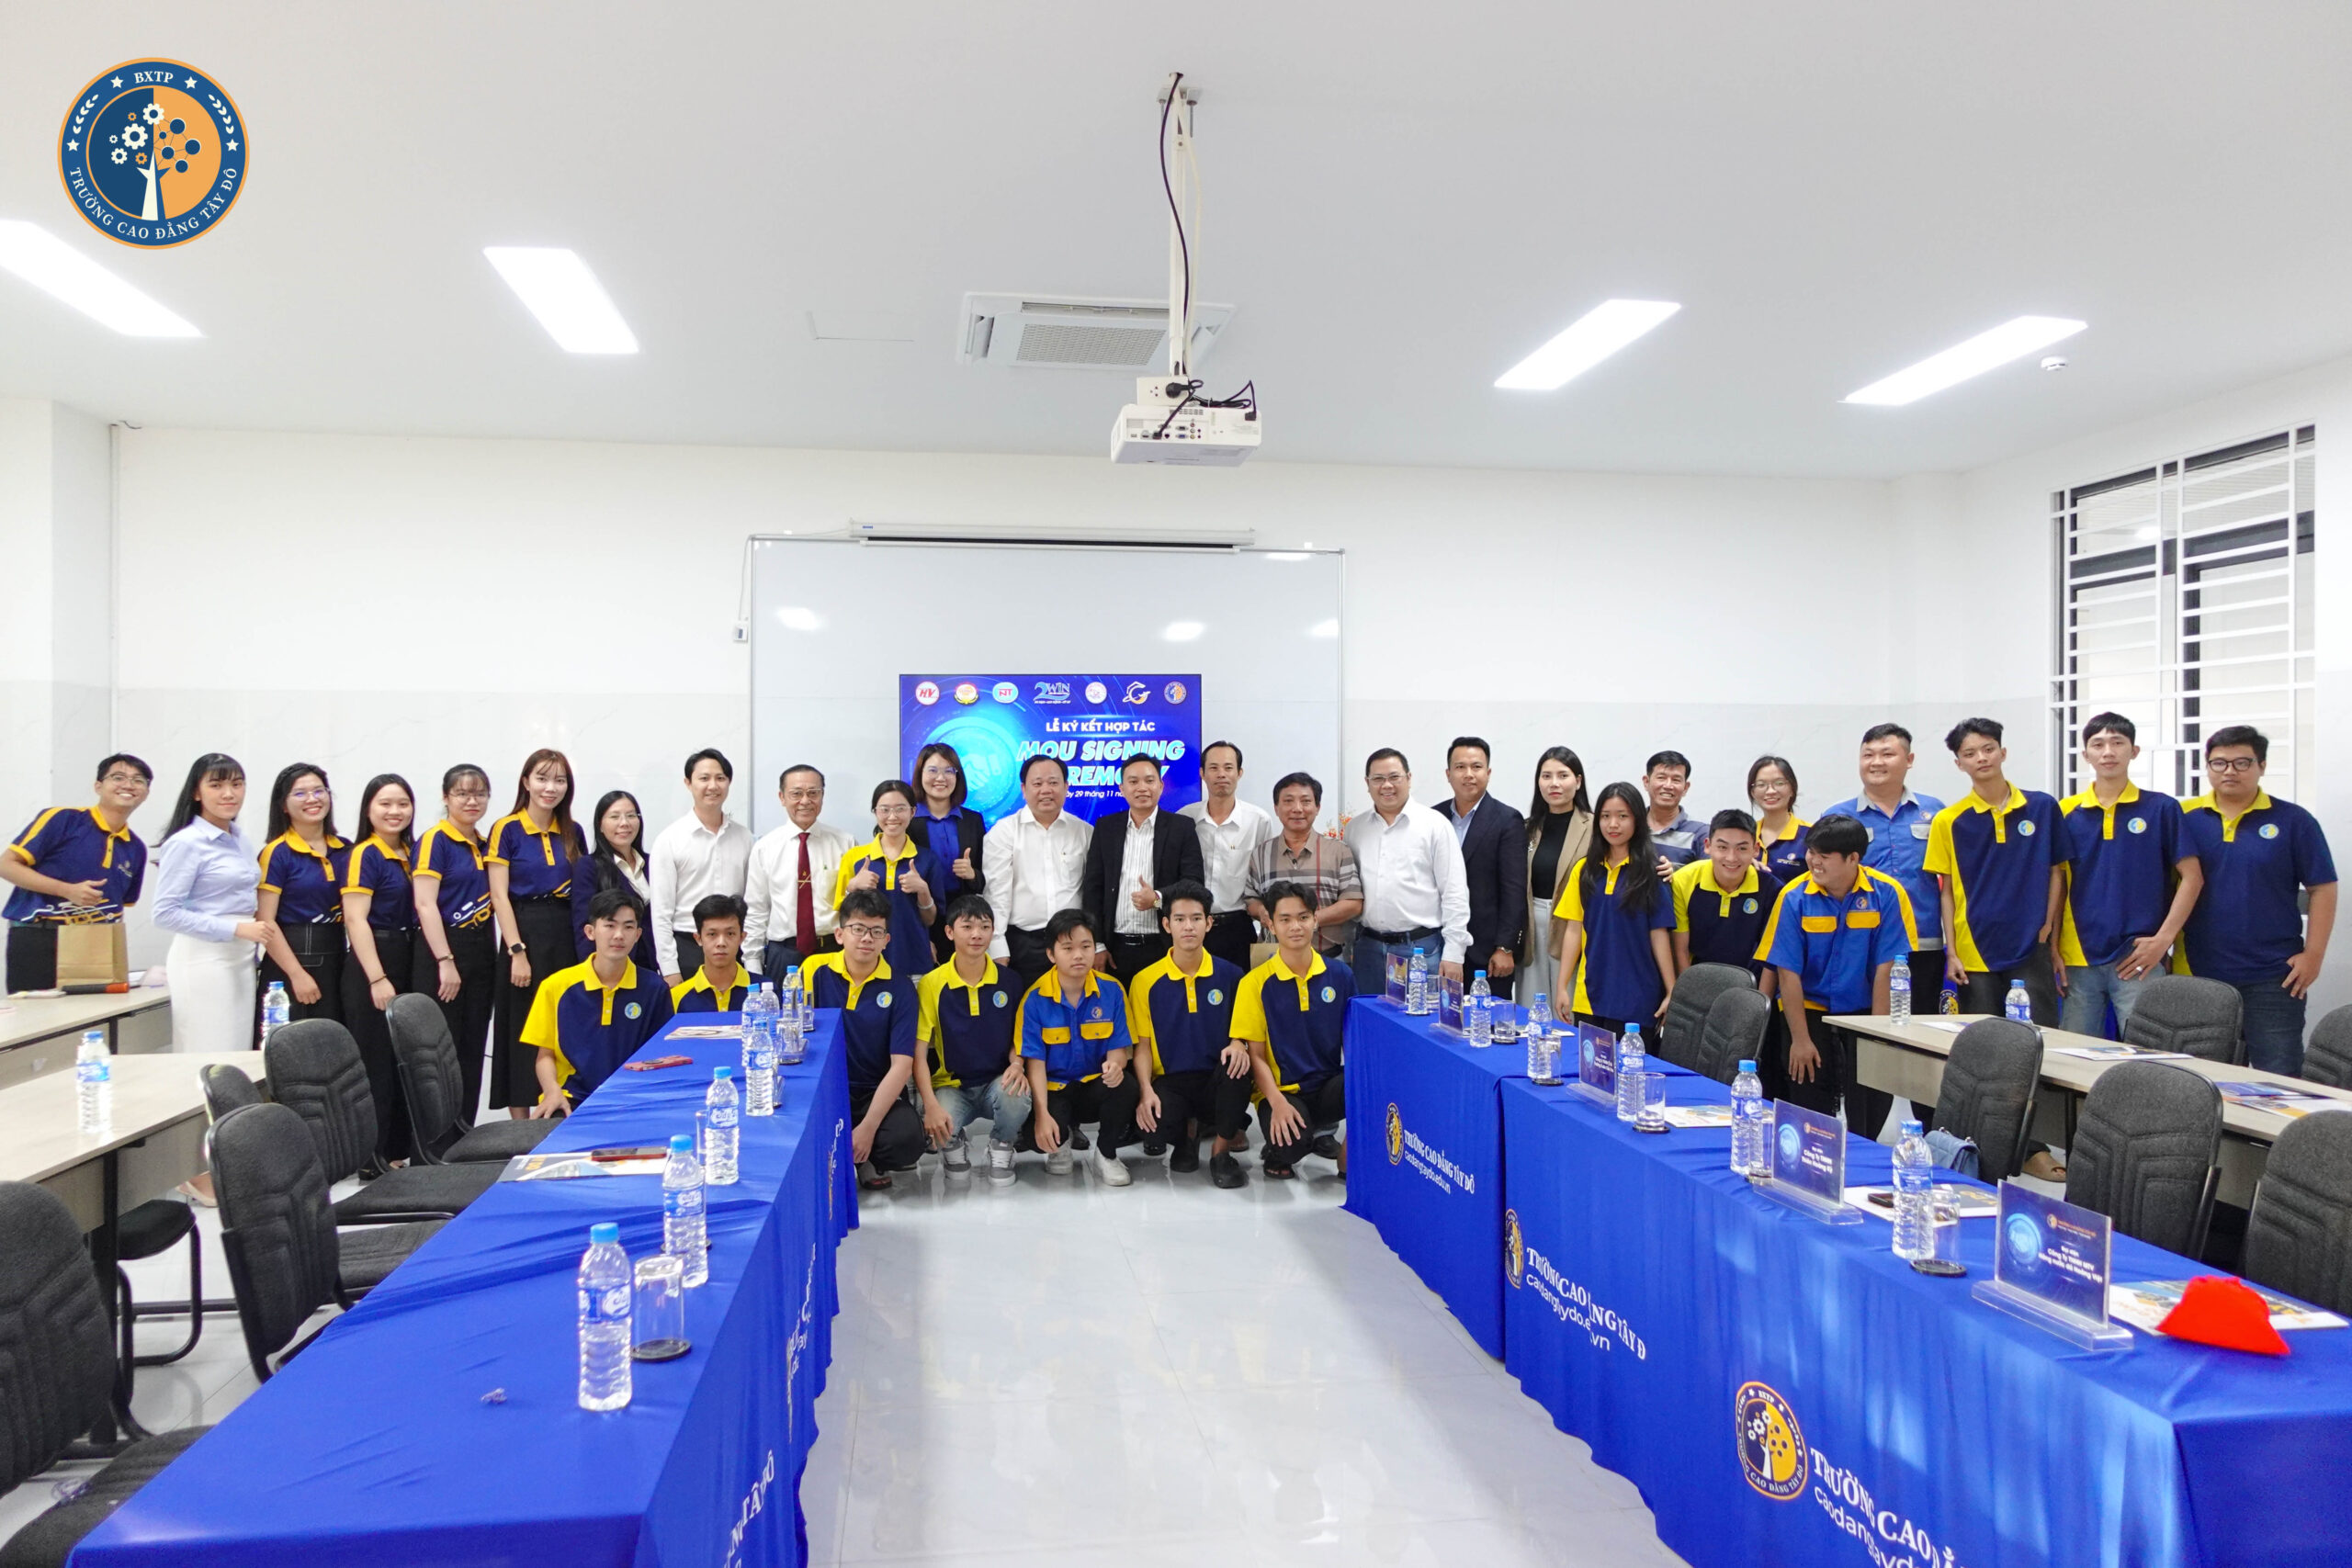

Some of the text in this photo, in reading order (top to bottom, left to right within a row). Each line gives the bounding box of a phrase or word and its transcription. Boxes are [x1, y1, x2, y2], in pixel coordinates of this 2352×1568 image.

[1046, 717, 1155, 734] LỄ KÝ KẾT HỢP TÁC
[1016, 740, 1185, 761] MOU SIGNING
[1084, 790, 1104, 799] tháng
[1425, 1145, 1437, 1165] CAO
[1559, 1277, 1587, 1306] CAO
[1750, 1472, 1767, 1488] CAO
[1810, 1447, 1930, 1561] TRƯỜNG CAO
